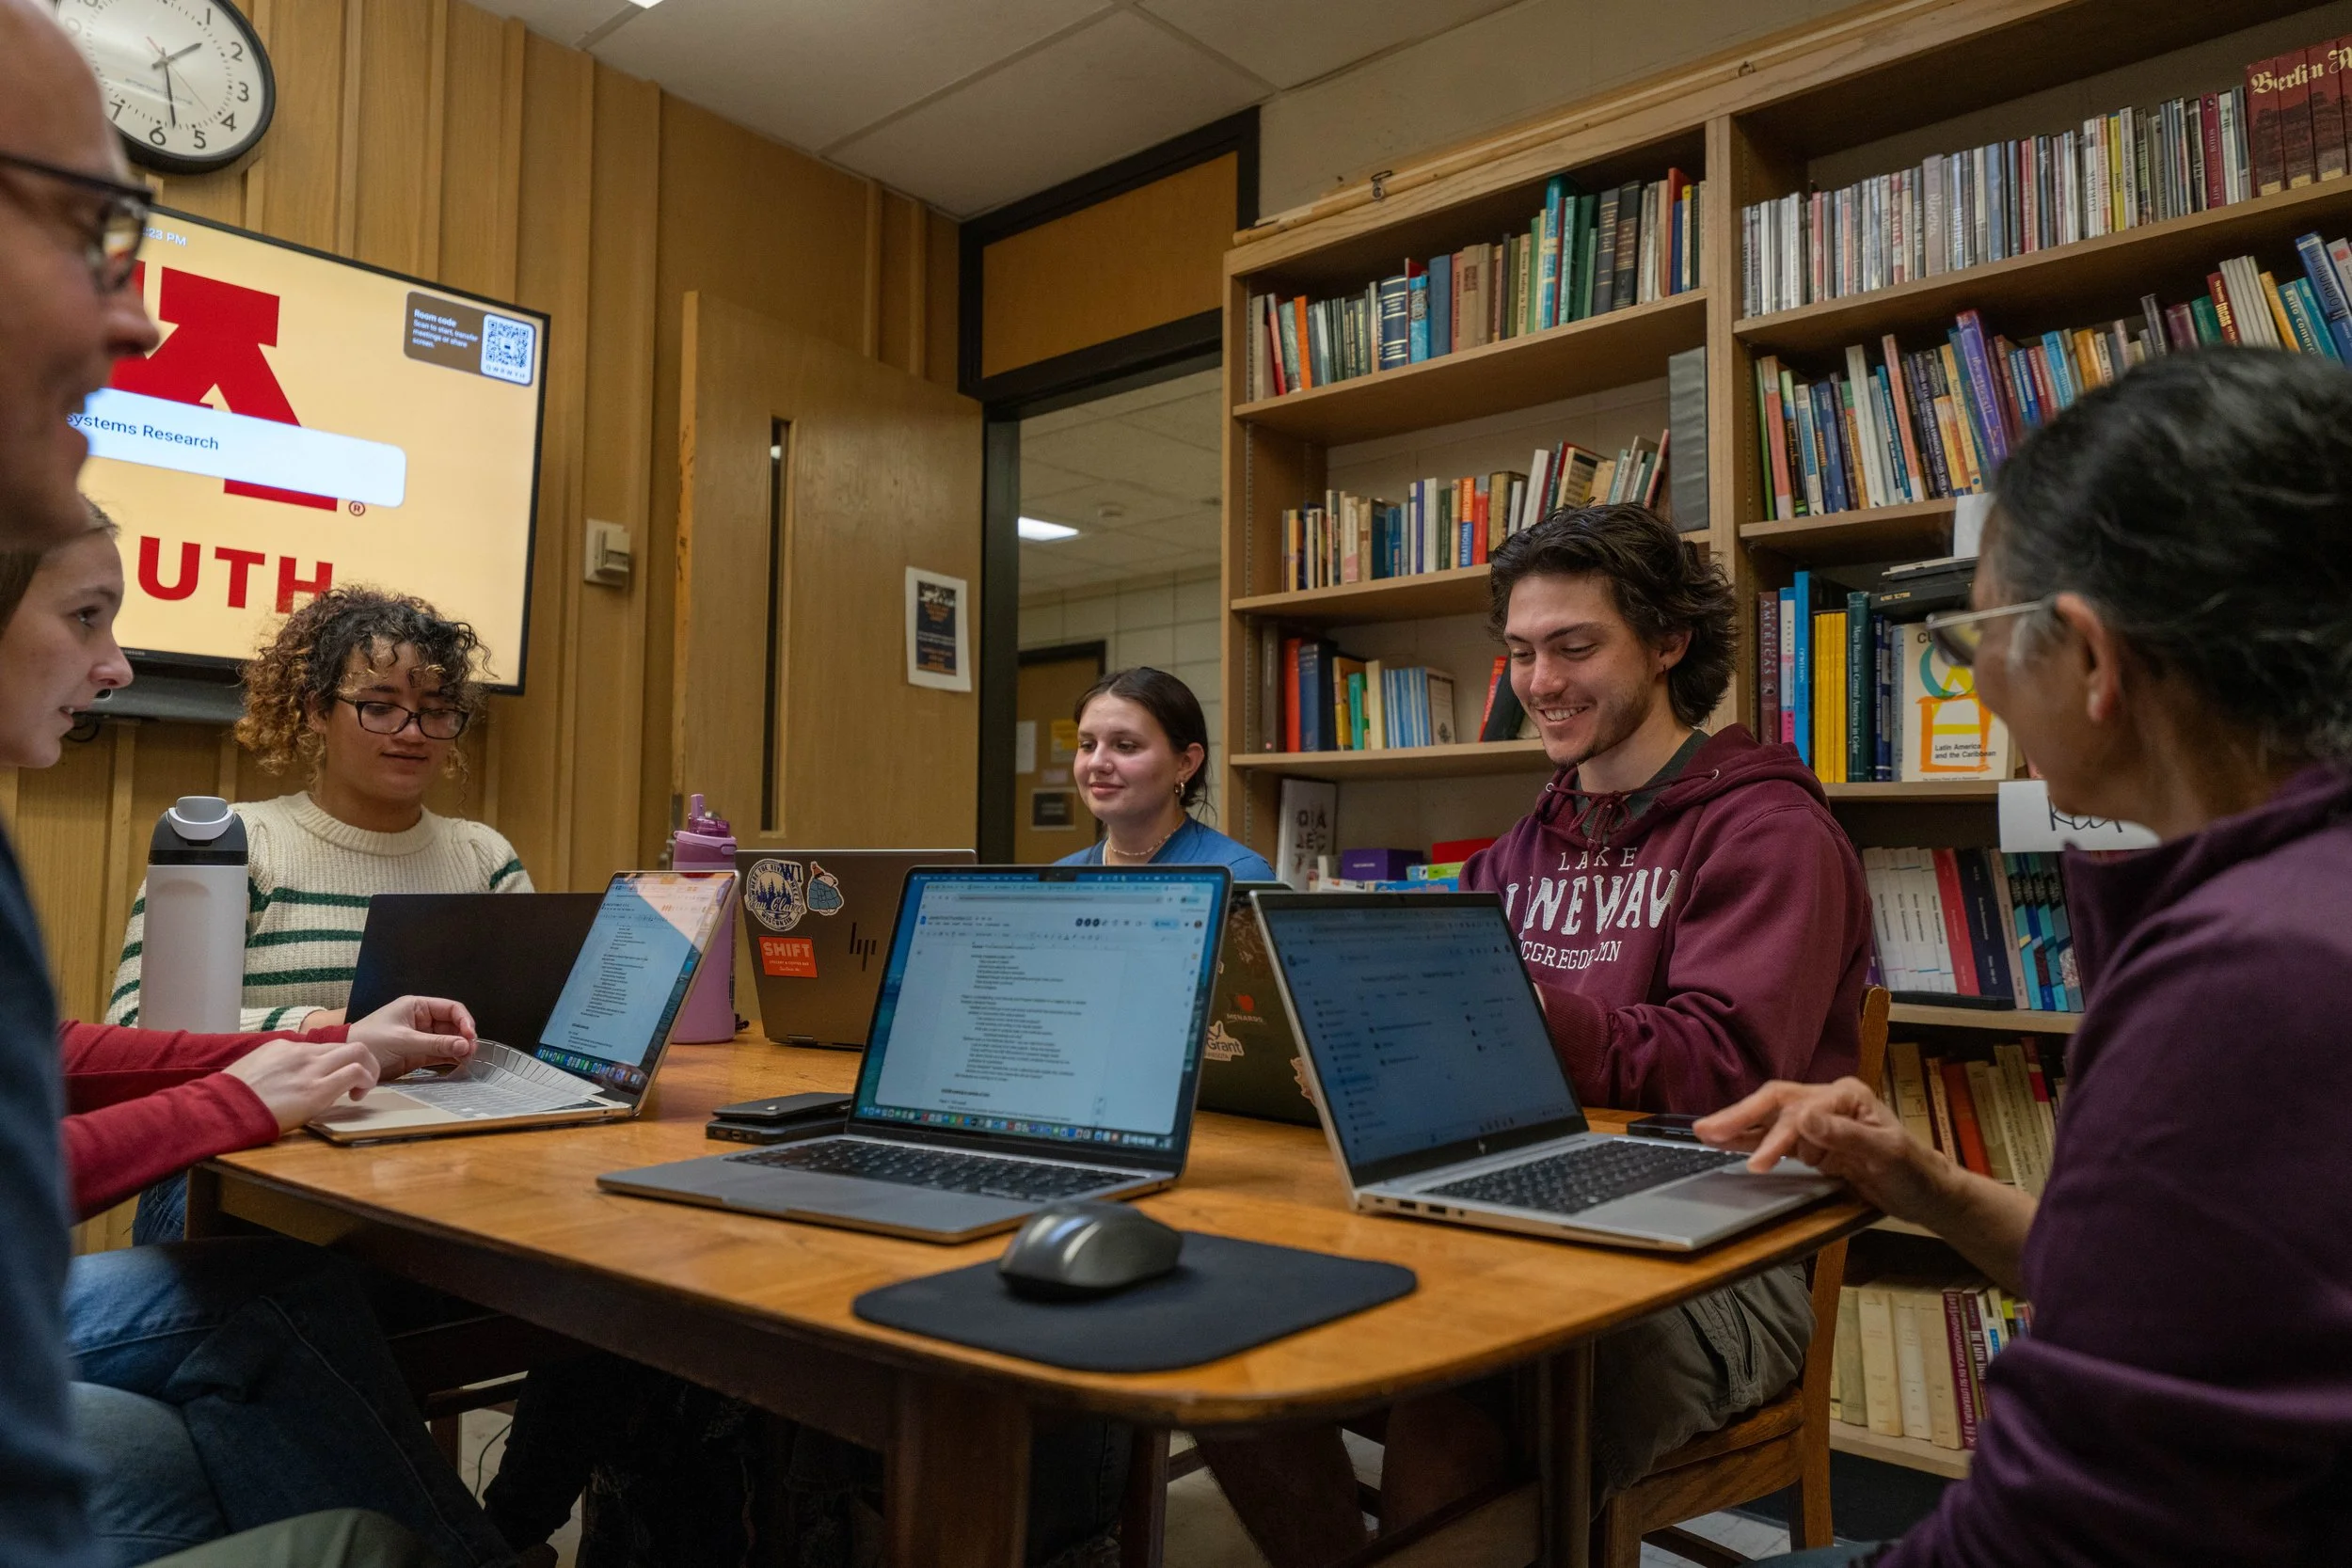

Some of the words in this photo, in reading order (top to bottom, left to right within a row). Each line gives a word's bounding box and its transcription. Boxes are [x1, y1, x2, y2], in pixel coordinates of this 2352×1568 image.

[230, 41, 243, 62] 2
[2250, 63, 2324, 94] Berlin
[237, 82, 249, 103] 3
[220, 112, 236, 132] 4
[149, 126, 167, 146] 6
[194, 130, 206, 150] 5
[1927, 193, 1944, 238] Rivera
[167, 231, 187, 246] PM
[1952, 207, 1963, 256] BIUTIFUL
[2313, 263, 2342, 307] MUNDO
[414, 309, 437, 323] Room
[2215, 301, 2234, 326] Incas
[143, 424, 220, 451] Research
[137, 535, 334, 614] UTH
[1762, 599, 1772, 674] AMERICAS
[1934, 743, 1952, 752] Latin
[1954, 743, 1981, 752] America
[1934, 751, 1948, 759] and
[1963, 750, 1996, 758] Caribbean
[1558, 847, 1638, 871] LAKE
[762, 942, 810, 958] SHIFT
[1595, 941, 1622, 962] MN
[1207, 1037, 1242, 1053] Grant
